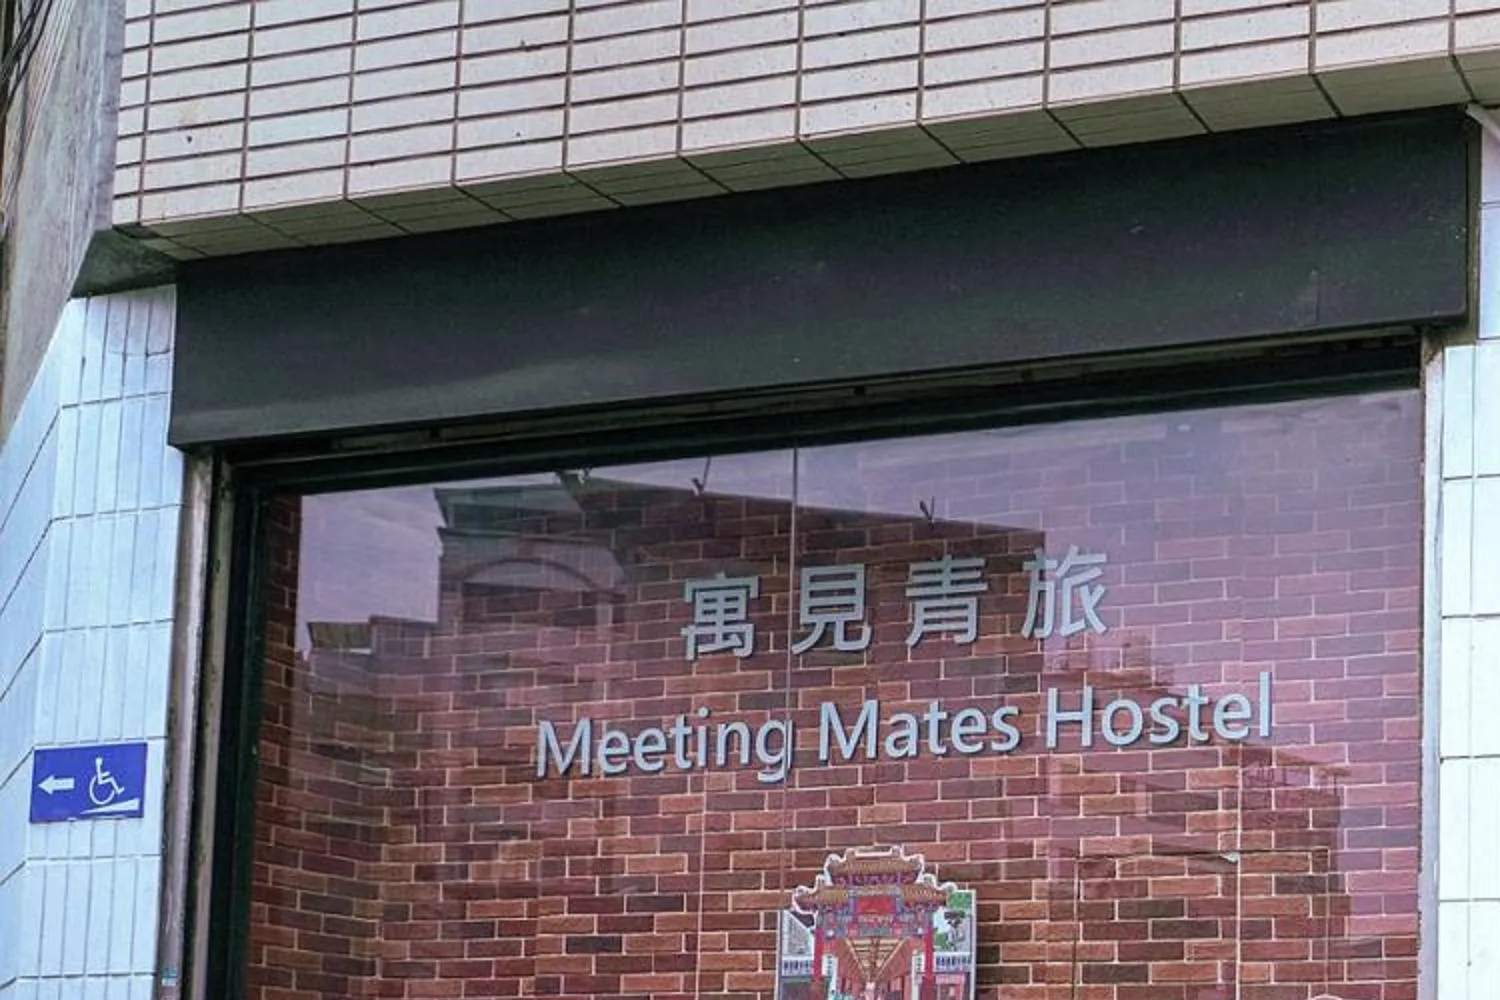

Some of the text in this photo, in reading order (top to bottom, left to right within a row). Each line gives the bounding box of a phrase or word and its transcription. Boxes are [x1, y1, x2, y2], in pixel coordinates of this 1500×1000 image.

[682, 547, 1108, 660] 寓見青旅
[536, 672, 1273, 783] Meeting Mates Hostel
